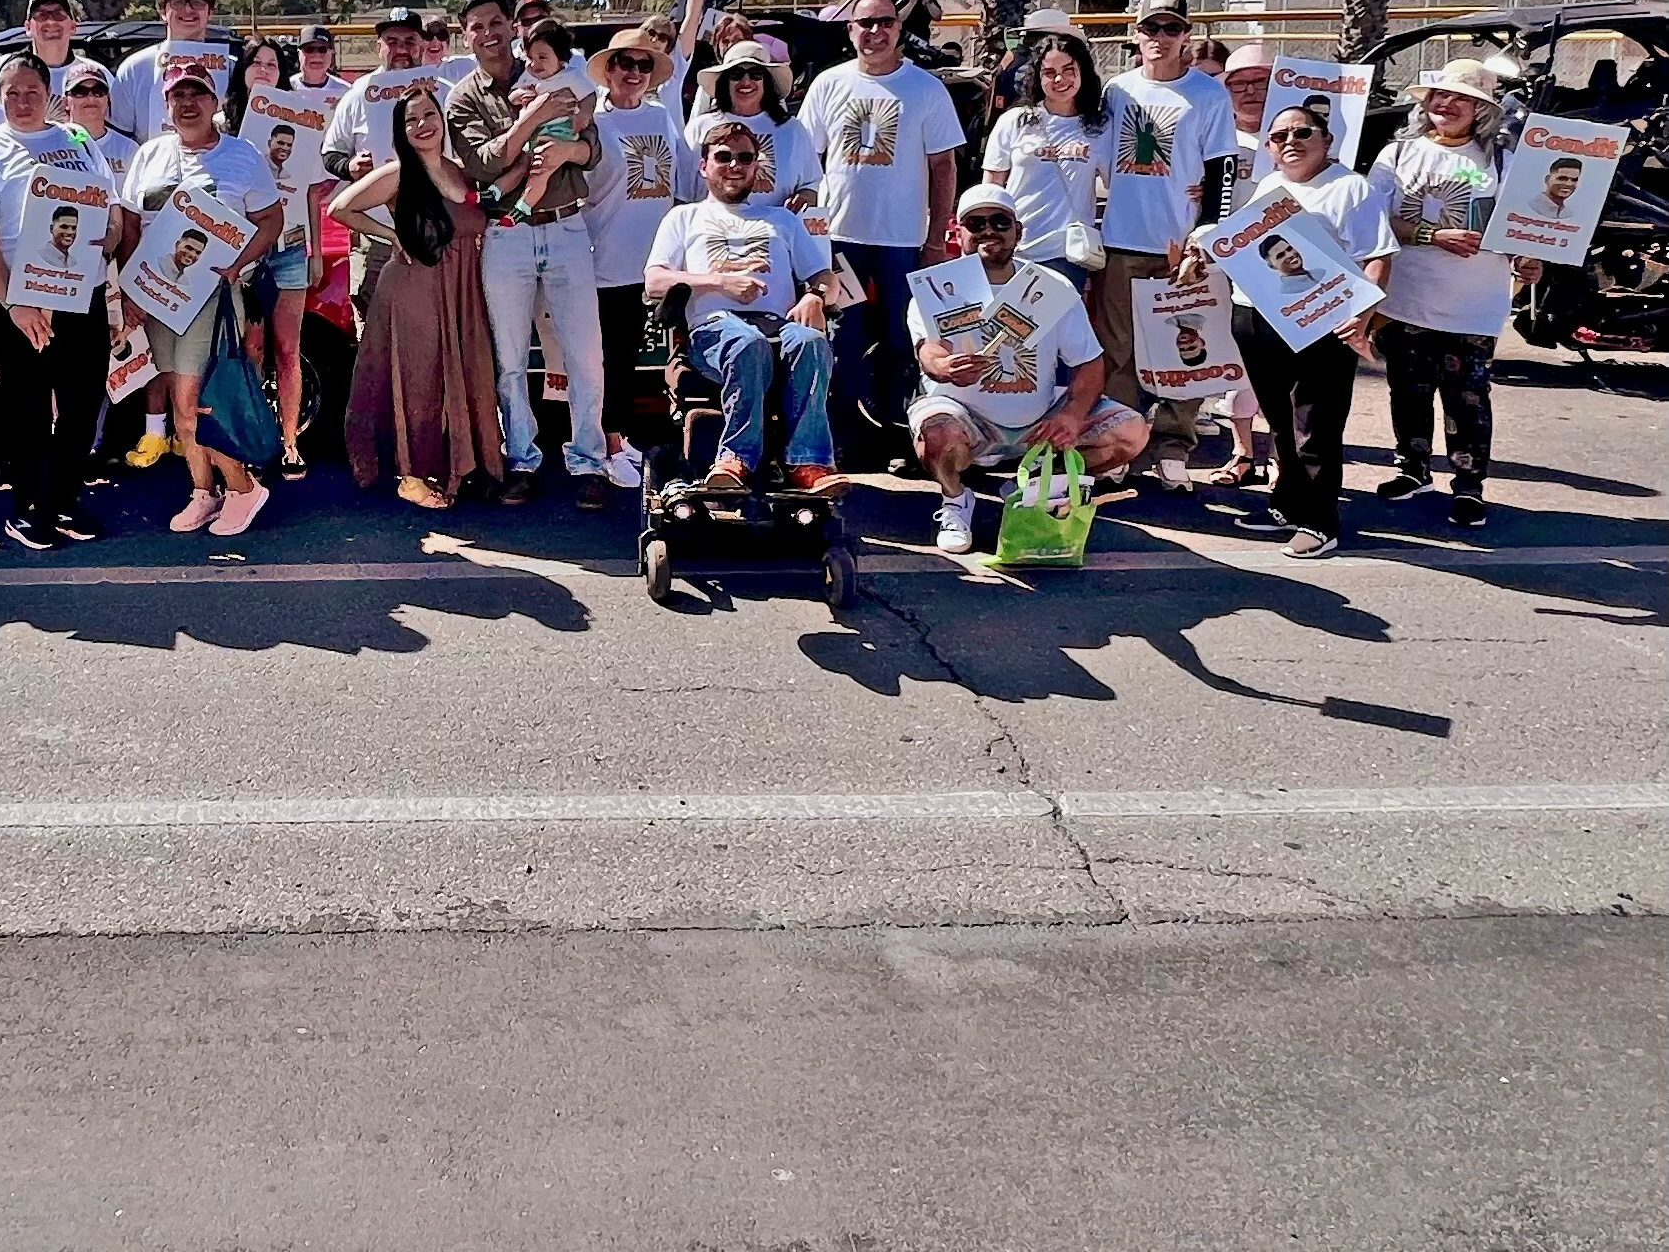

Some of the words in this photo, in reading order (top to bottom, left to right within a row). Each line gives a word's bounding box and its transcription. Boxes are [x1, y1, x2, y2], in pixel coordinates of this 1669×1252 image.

[1274, 68, 1367, 96] Condit
[250, 95, 326, 131] Condit
[1524, 127, 1619, 160] Condit
[31, 176, 109, 208] Condit
[172, 190, 247, 251] Condit
[1211, 196, 1303, 258] Condit
[1139, 363, 1244, 388] Condit
